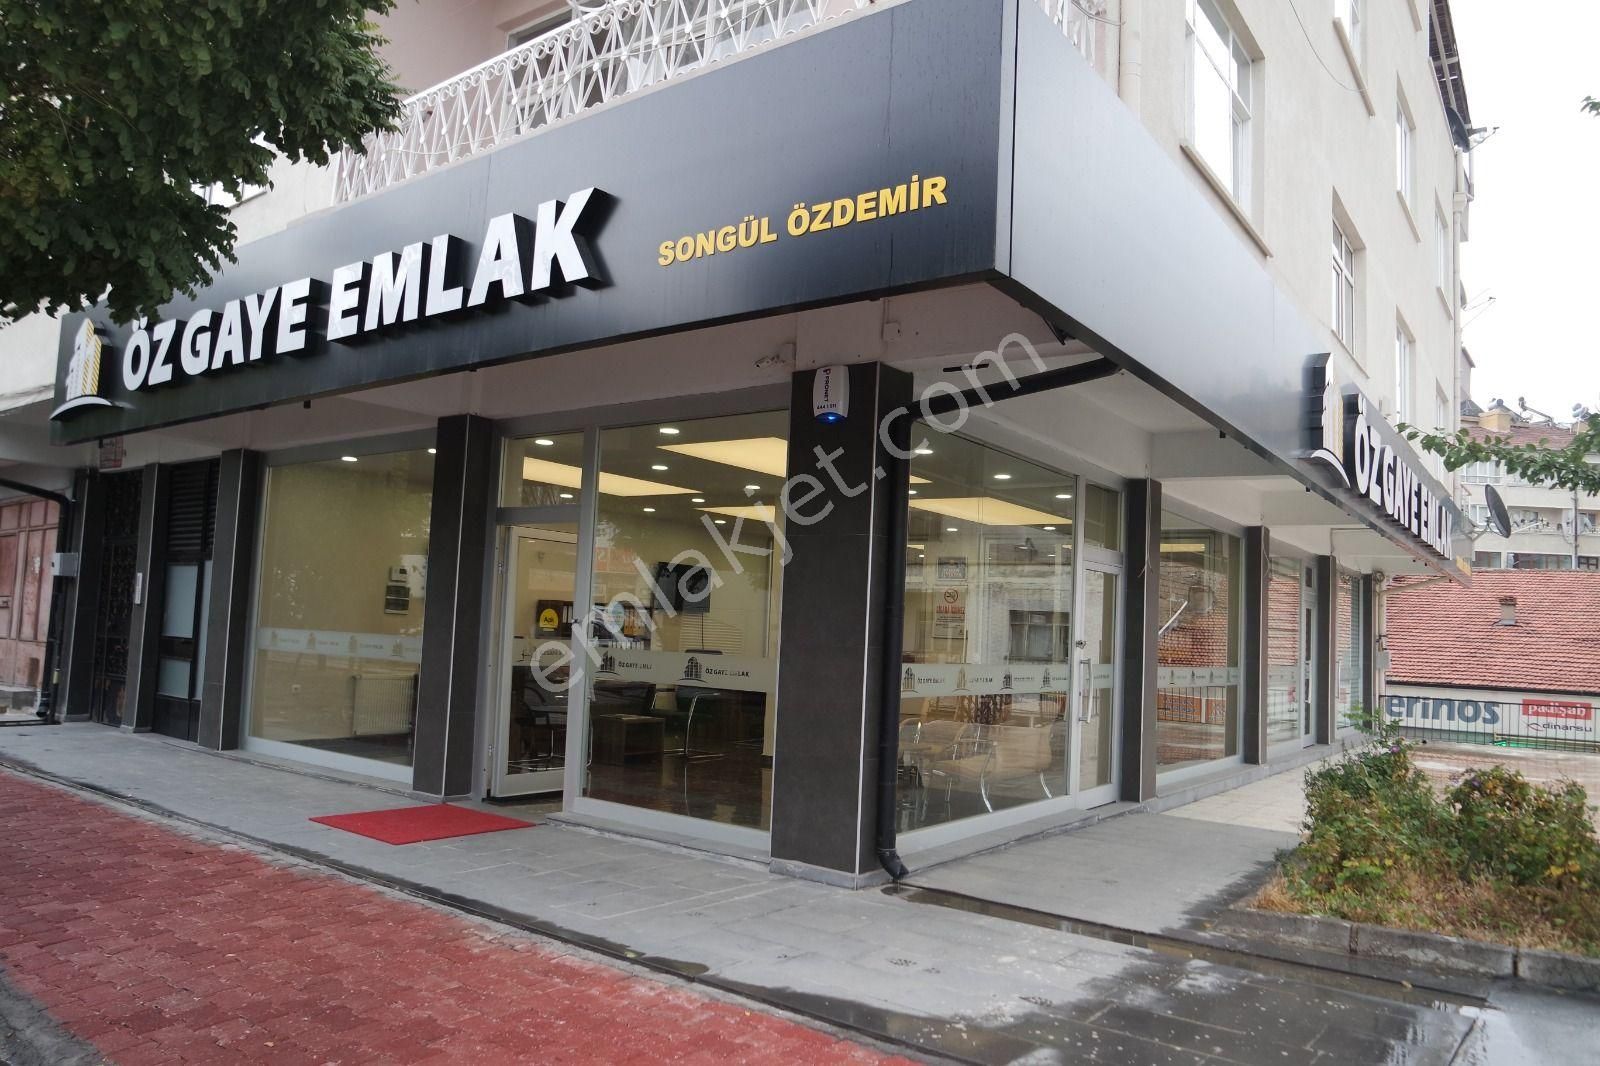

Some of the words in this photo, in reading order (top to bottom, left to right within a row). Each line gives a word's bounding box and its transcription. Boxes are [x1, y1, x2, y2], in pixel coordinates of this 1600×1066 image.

[657, 214, 778, 267] SONGÜL
[787, 174, 948, 237] ÖZDEMİR
[327, 187, 596, 342] EMLAK
[1420, 484, 1453, 562] EMLAK
[1542, 721, 1593, 733] dinarsu
